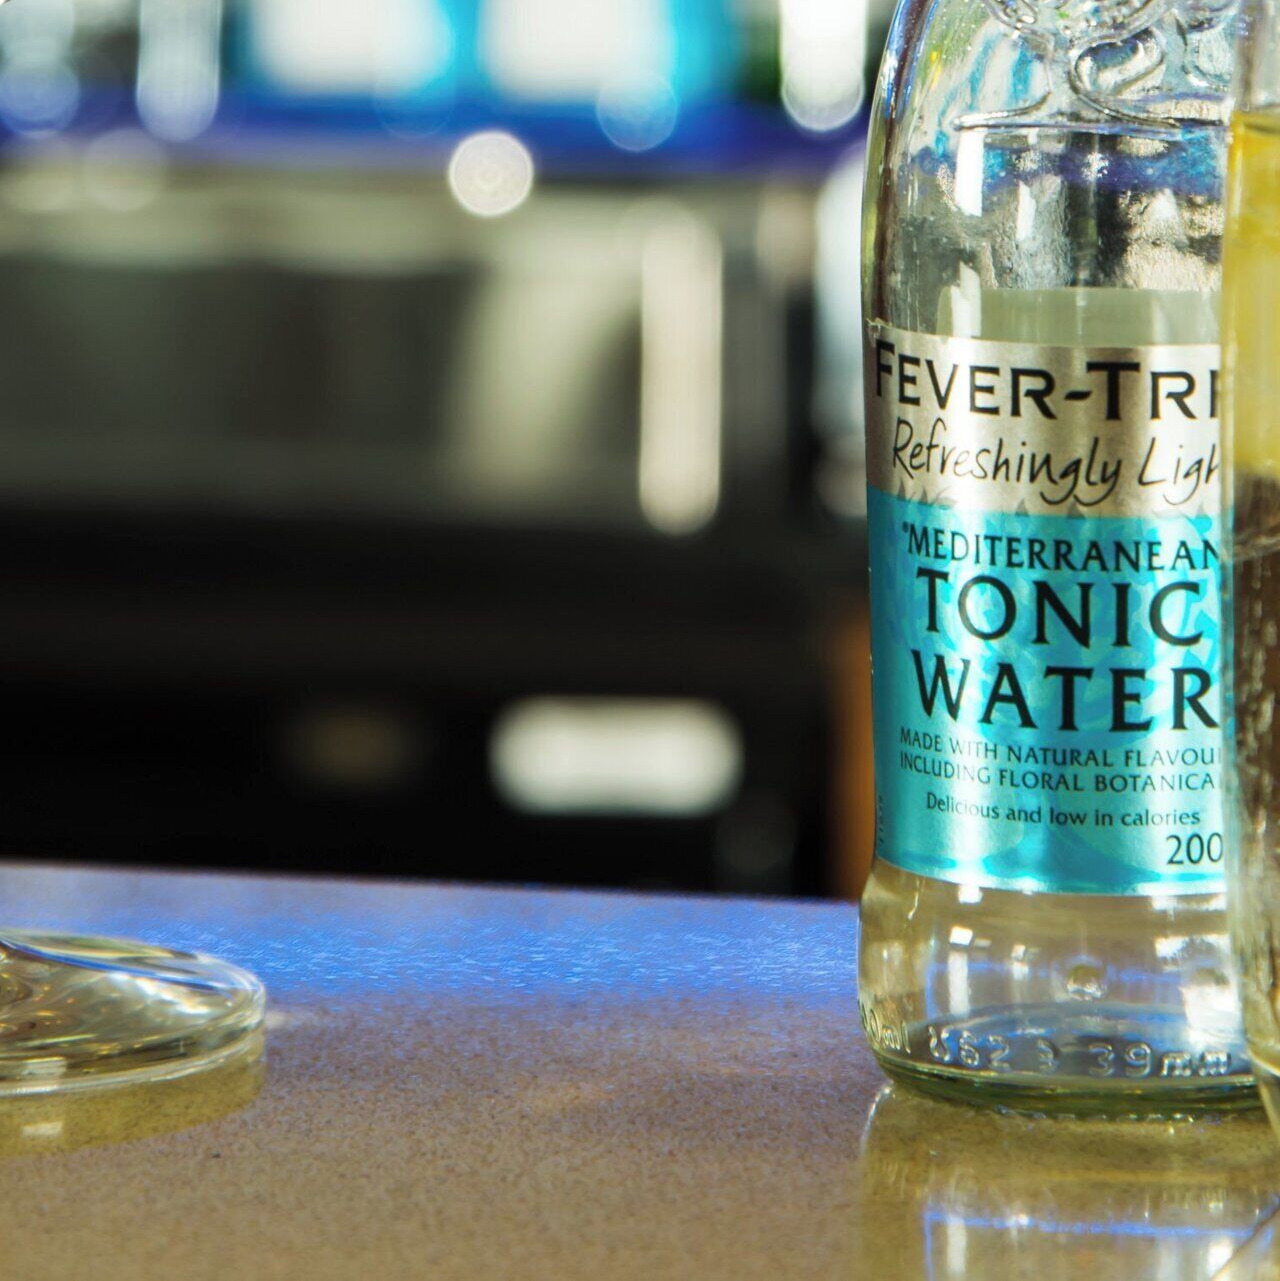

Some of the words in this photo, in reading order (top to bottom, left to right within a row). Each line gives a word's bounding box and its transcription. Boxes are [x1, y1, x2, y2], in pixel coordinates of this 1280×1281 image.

[892, 416, 1122, 507] Refreshingly
[1137, 436, 1219, 506] Ligh
[915, 567, 1204, 650] TONIC
[910, 648, 1220, 733] WATER
[899, 726, 943, 753] MADE
[949, 736, 998, 761] WITH
[1007, 745, 1114, 768] NATURAL
[1124, 747, 1222, 768] FLAVOU
[899, 751, 992, 786] INCLUDING
[998, 768, 1085, 793] FLORAL
[1094, 772, 1216, 793] BOTANICA
[926, 791, 1000, 820] Delicious
[1006, 807, 1042, 824] and
[1049, 807, 1088, 827] low
[1094, 808, 1114, 827] in
[1120, 808, 1202, 827] calories
